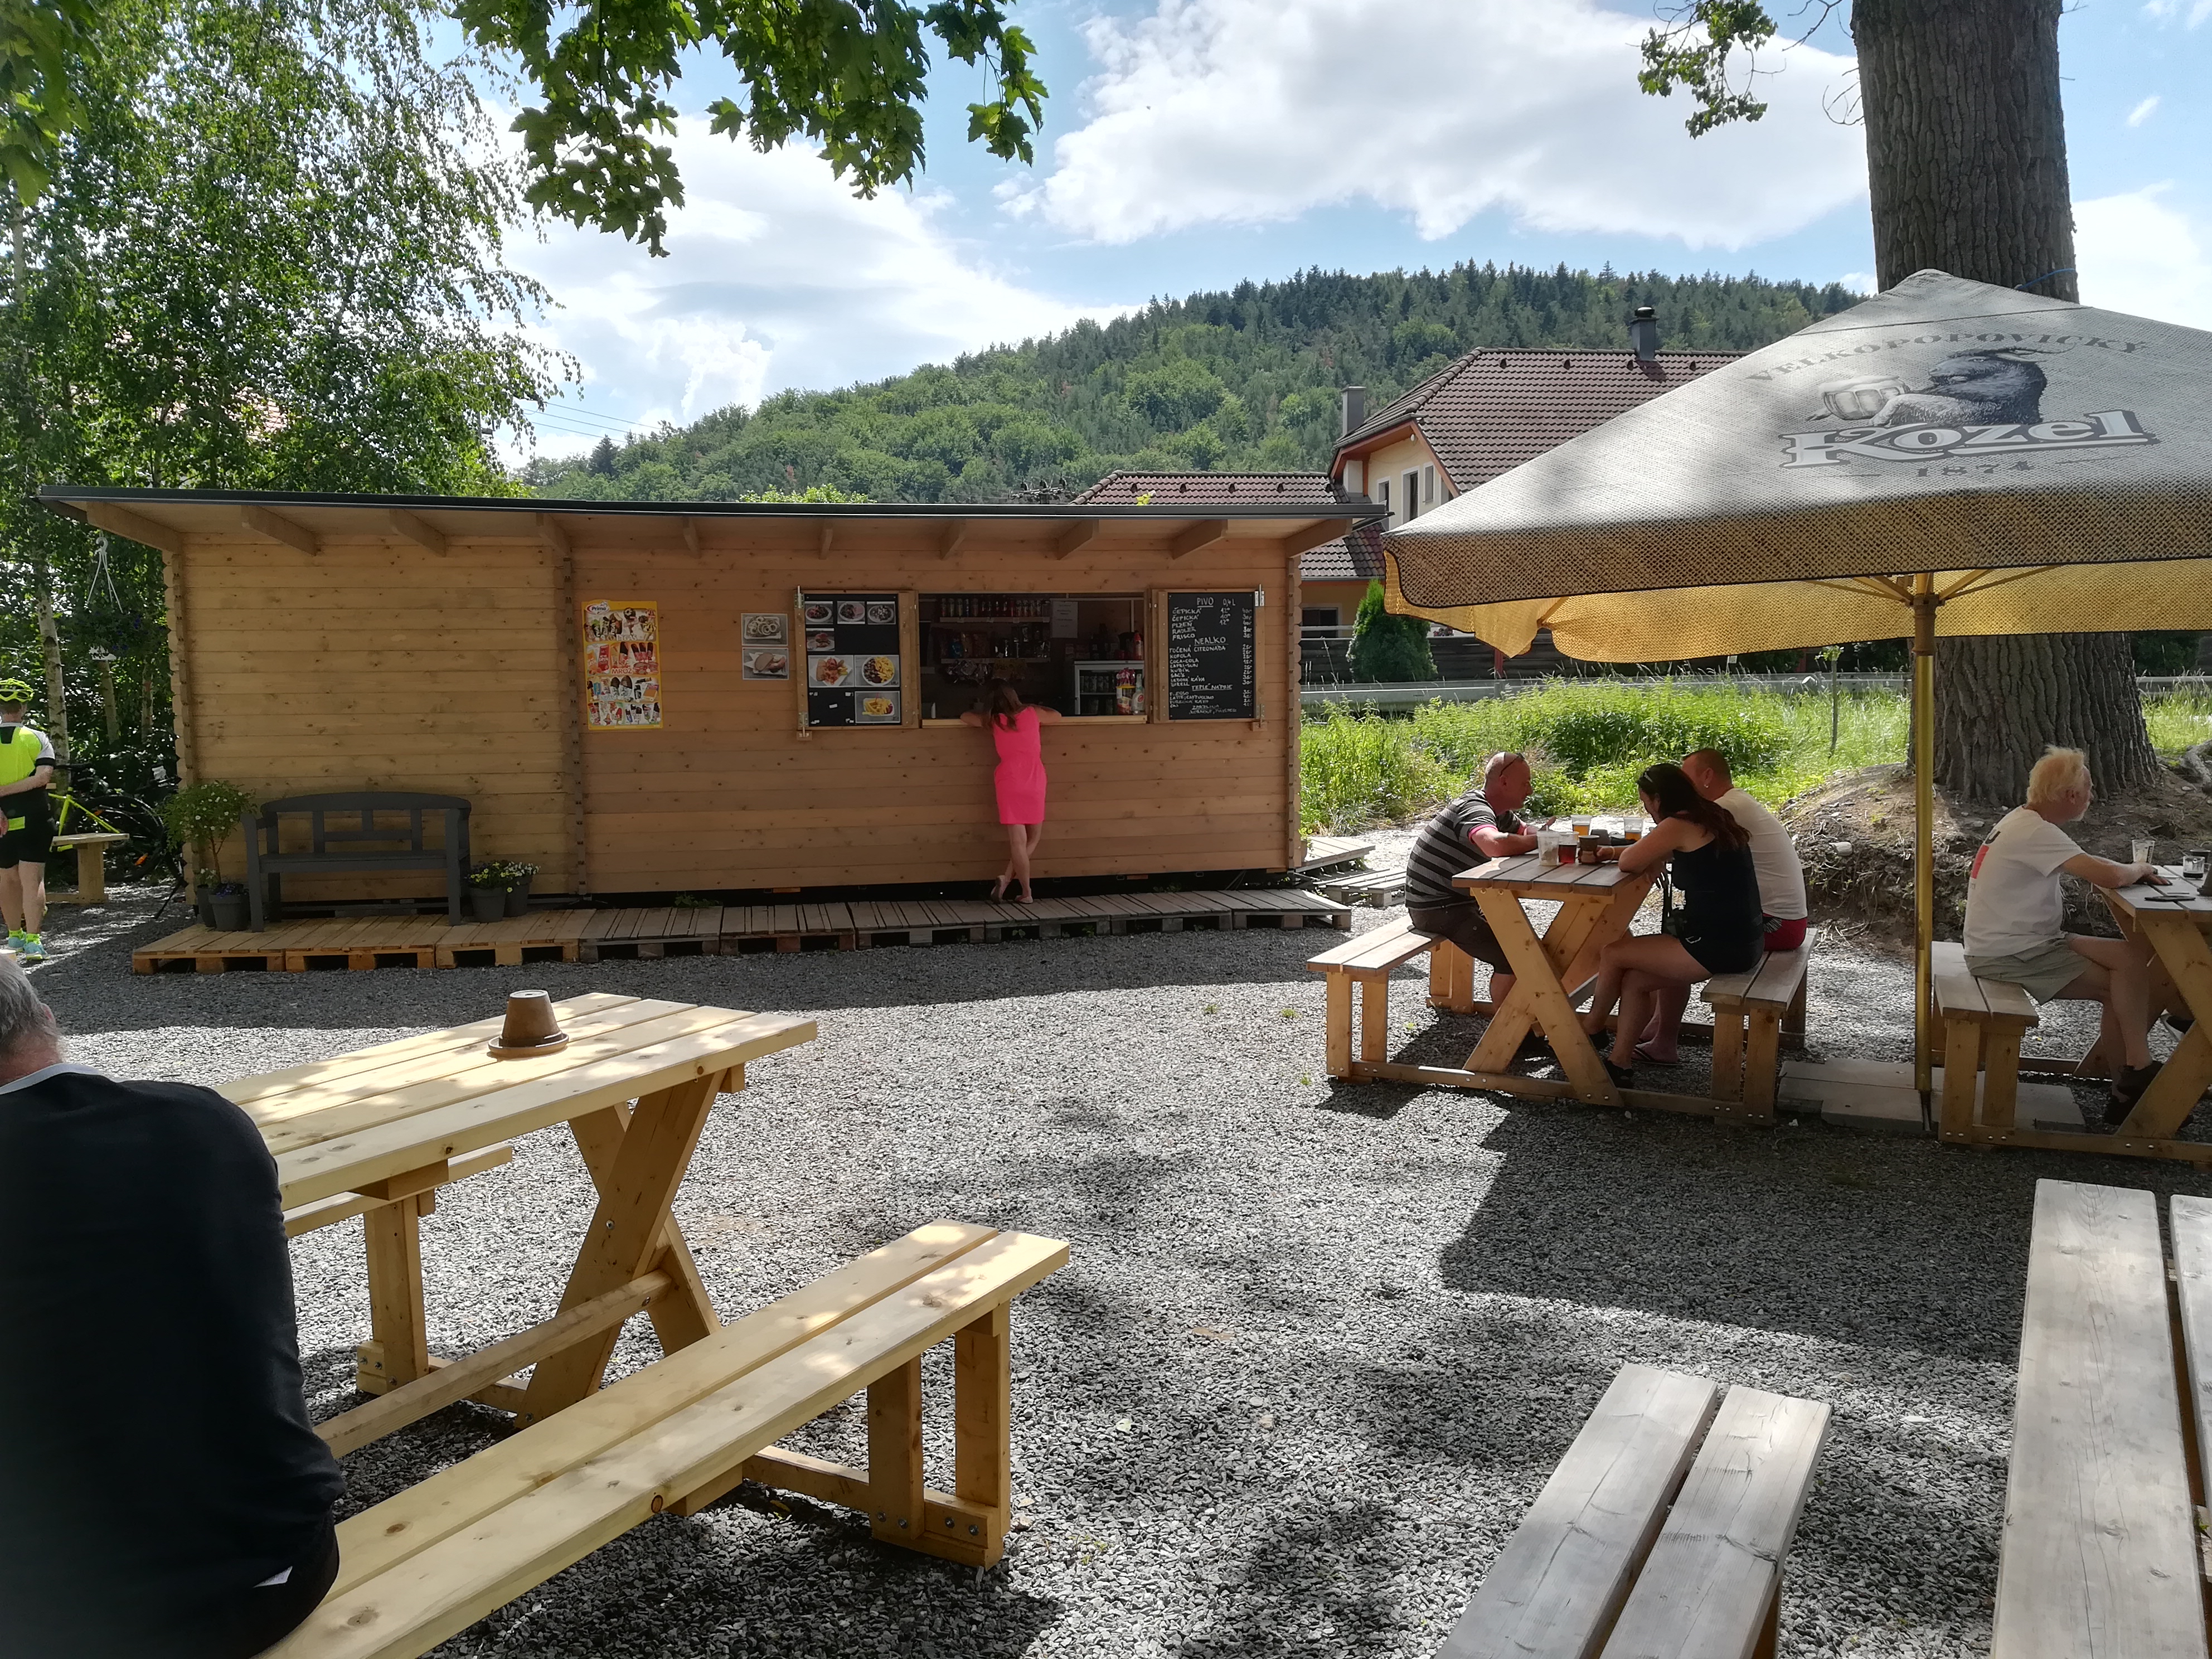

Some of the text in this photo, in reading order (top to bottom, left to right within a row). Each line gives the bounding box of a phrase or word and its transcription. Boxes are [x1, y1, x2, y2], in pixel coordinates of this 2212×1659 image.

[1779, 409, 2146, 469] Kozel
[1917, 460, 2035, 478] 1874
[1197, 597, 1214, 605] PIVO
[1194, 637, 1226, 645] NEALKO
[1169, 644, 1191, 653] TOČENÁ
